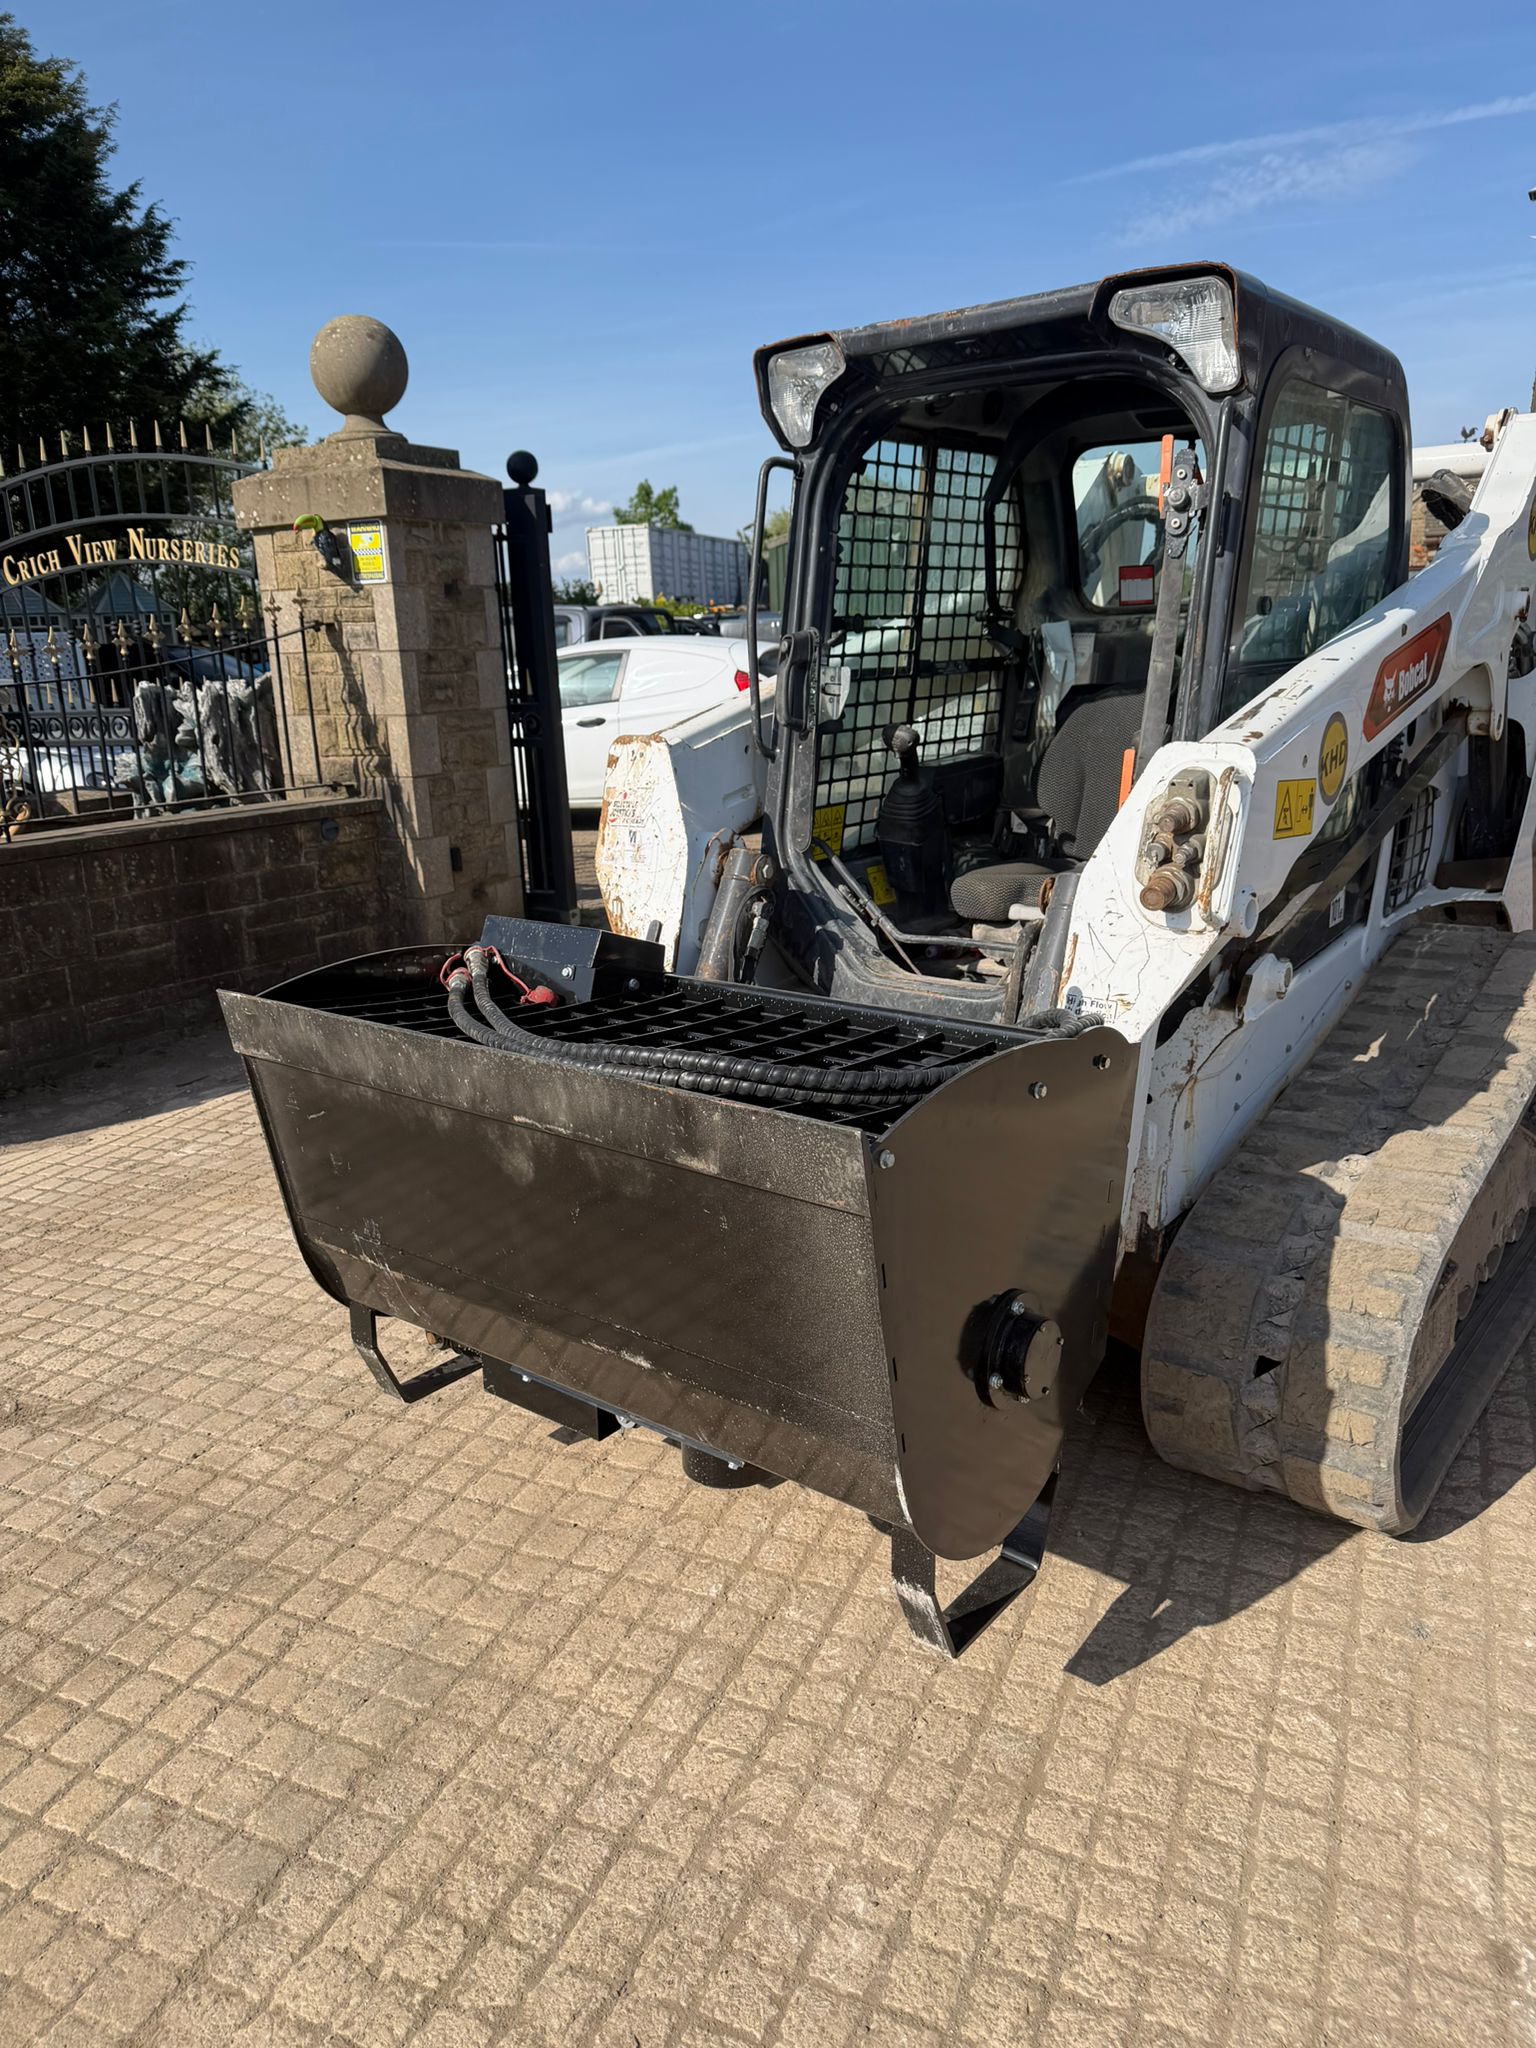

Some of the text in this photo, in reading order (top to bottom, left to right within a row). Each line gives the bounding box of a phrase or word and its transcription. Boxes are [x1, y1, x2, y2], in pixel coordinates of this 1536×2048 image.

[3, 527, 241, 586] CRICH VIEW NURSERIES
[1398, 651, 1428, 702] Bobcat
[1320, 738, 1347, 778] KHD
